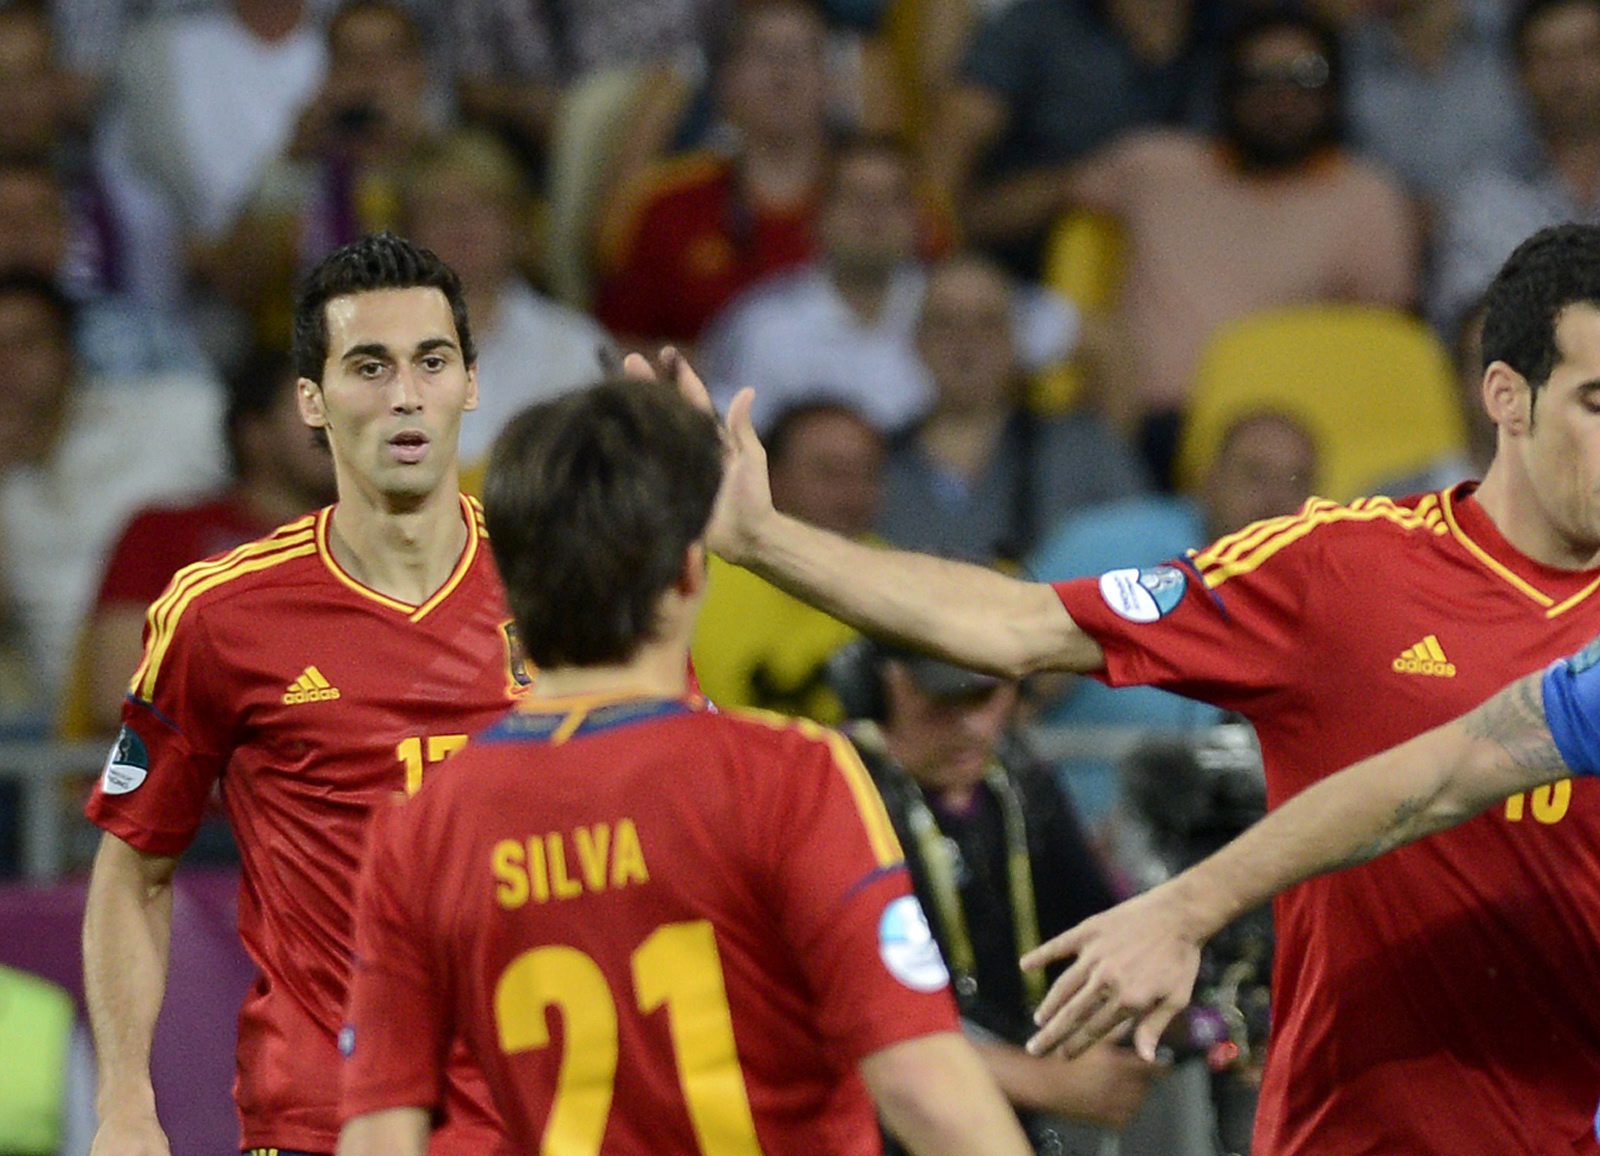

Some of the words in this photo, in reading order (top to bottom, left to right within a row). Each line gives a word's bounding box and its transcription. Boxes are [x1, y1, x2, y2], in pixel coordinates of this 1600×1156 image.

[1392, 658, 1457, 678] adidas
[282, 687, 341, 705] adidas
[491, 816, 650, 910] SILVA
